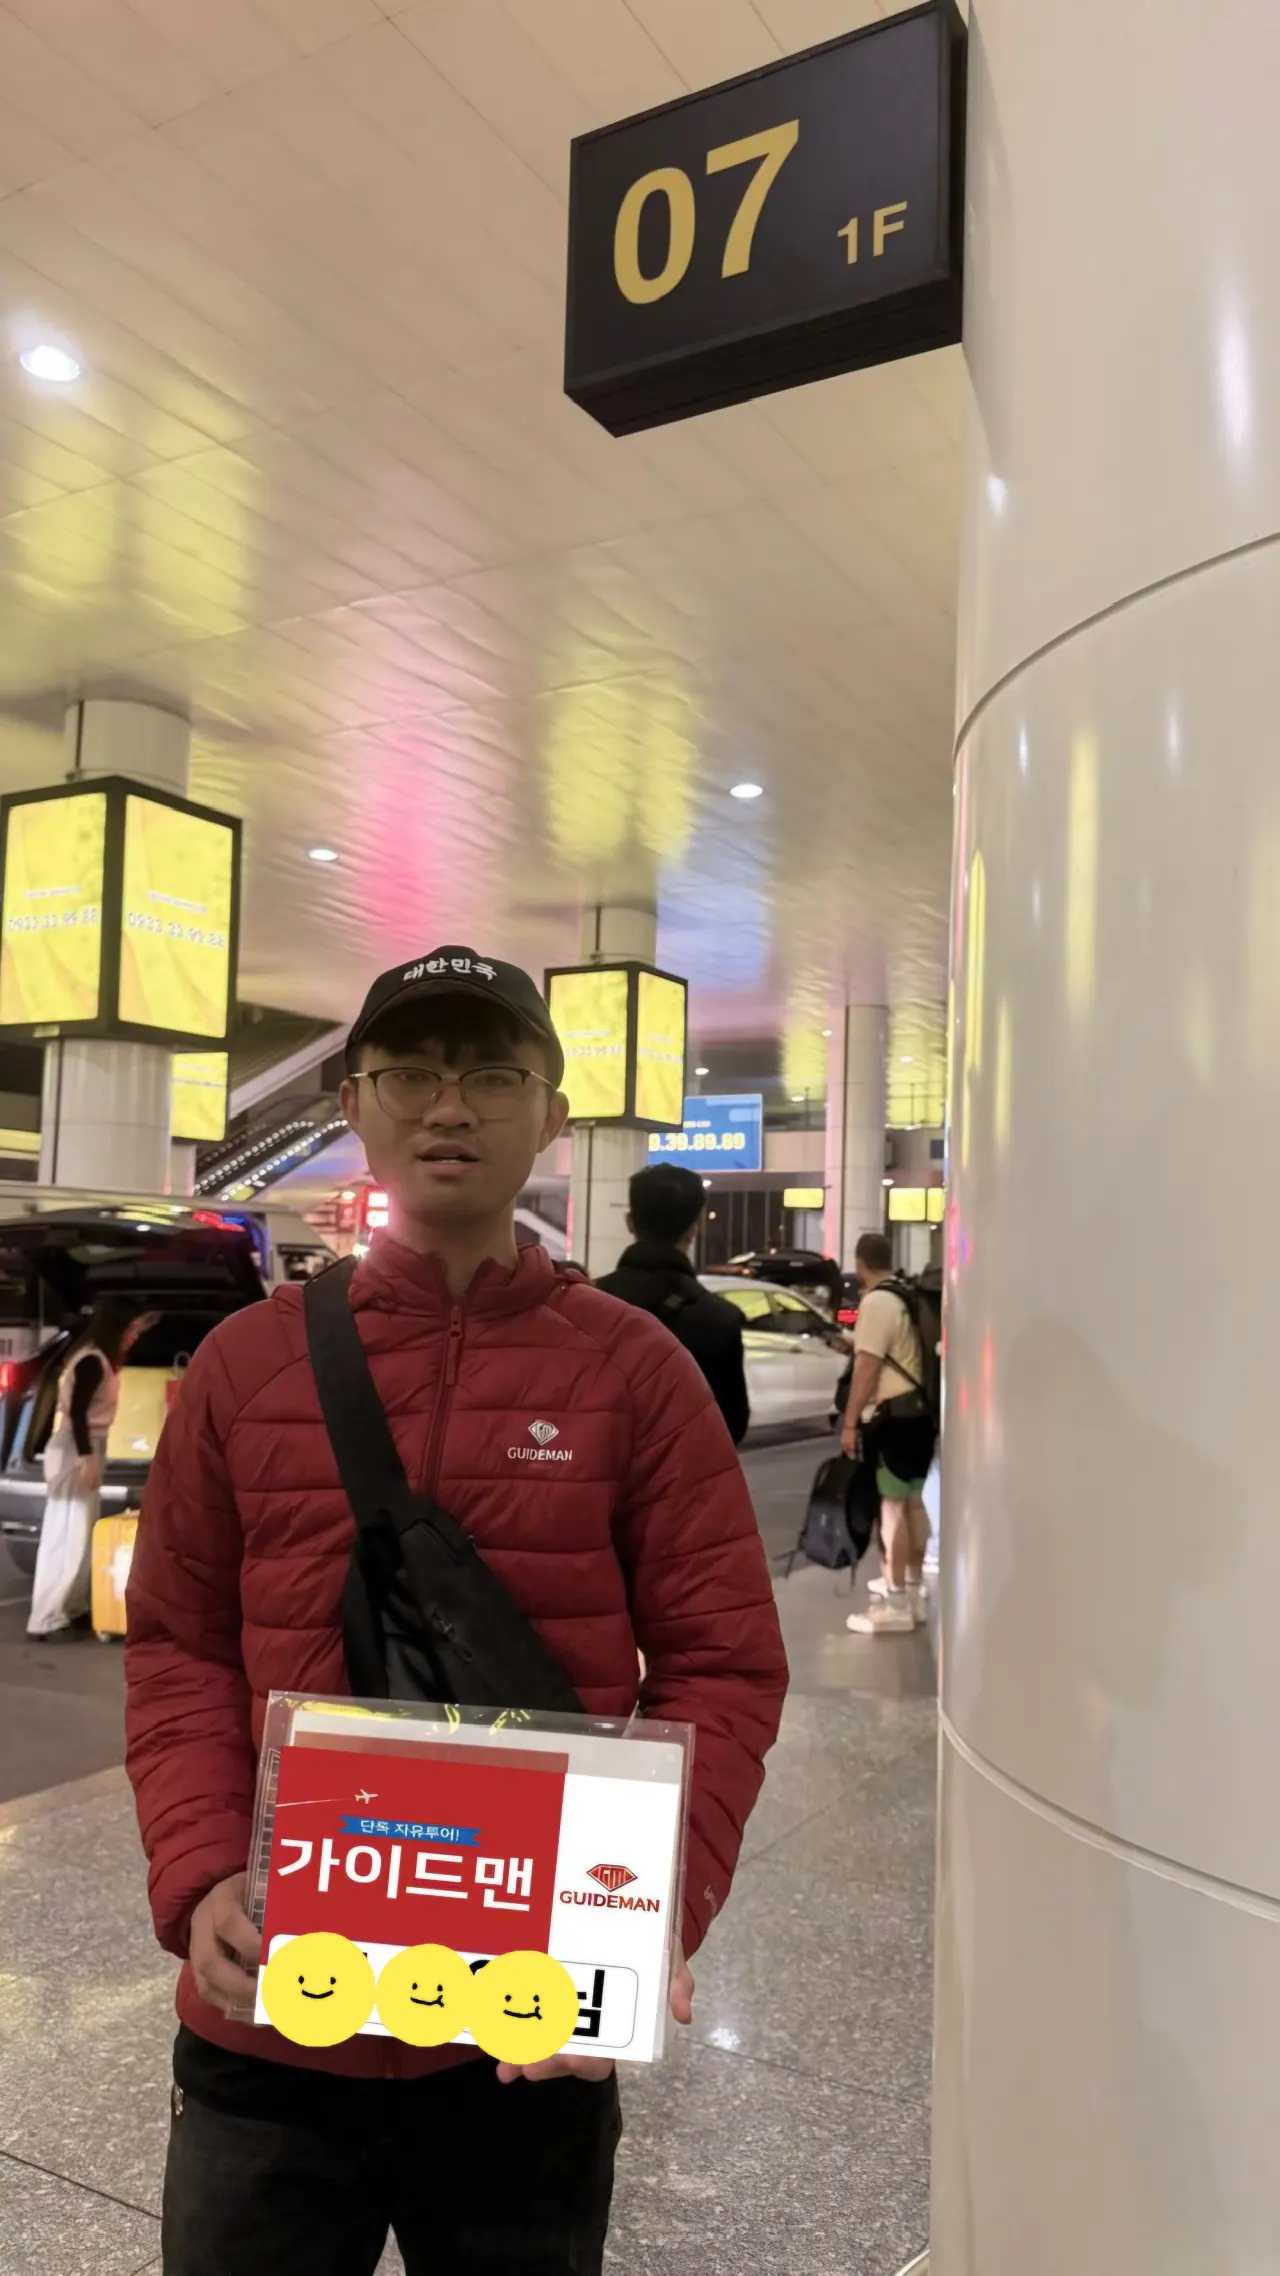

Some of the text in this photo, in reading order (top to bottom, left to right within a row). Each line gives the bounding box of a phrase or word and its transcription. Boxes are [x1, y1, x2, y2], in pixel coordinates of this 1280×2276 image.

[613, 119, 908, 304] 07 1F
[403, 957, 497, 981] 대한민국
[507, 1446, 573, 1461] GUIDEMAN
[394, 1823, 460, 1841] 자유투어!
[277, 1837, 534, 1912] 가이드맨
[559, 1890, 660, 1913] GUIDEMAN
